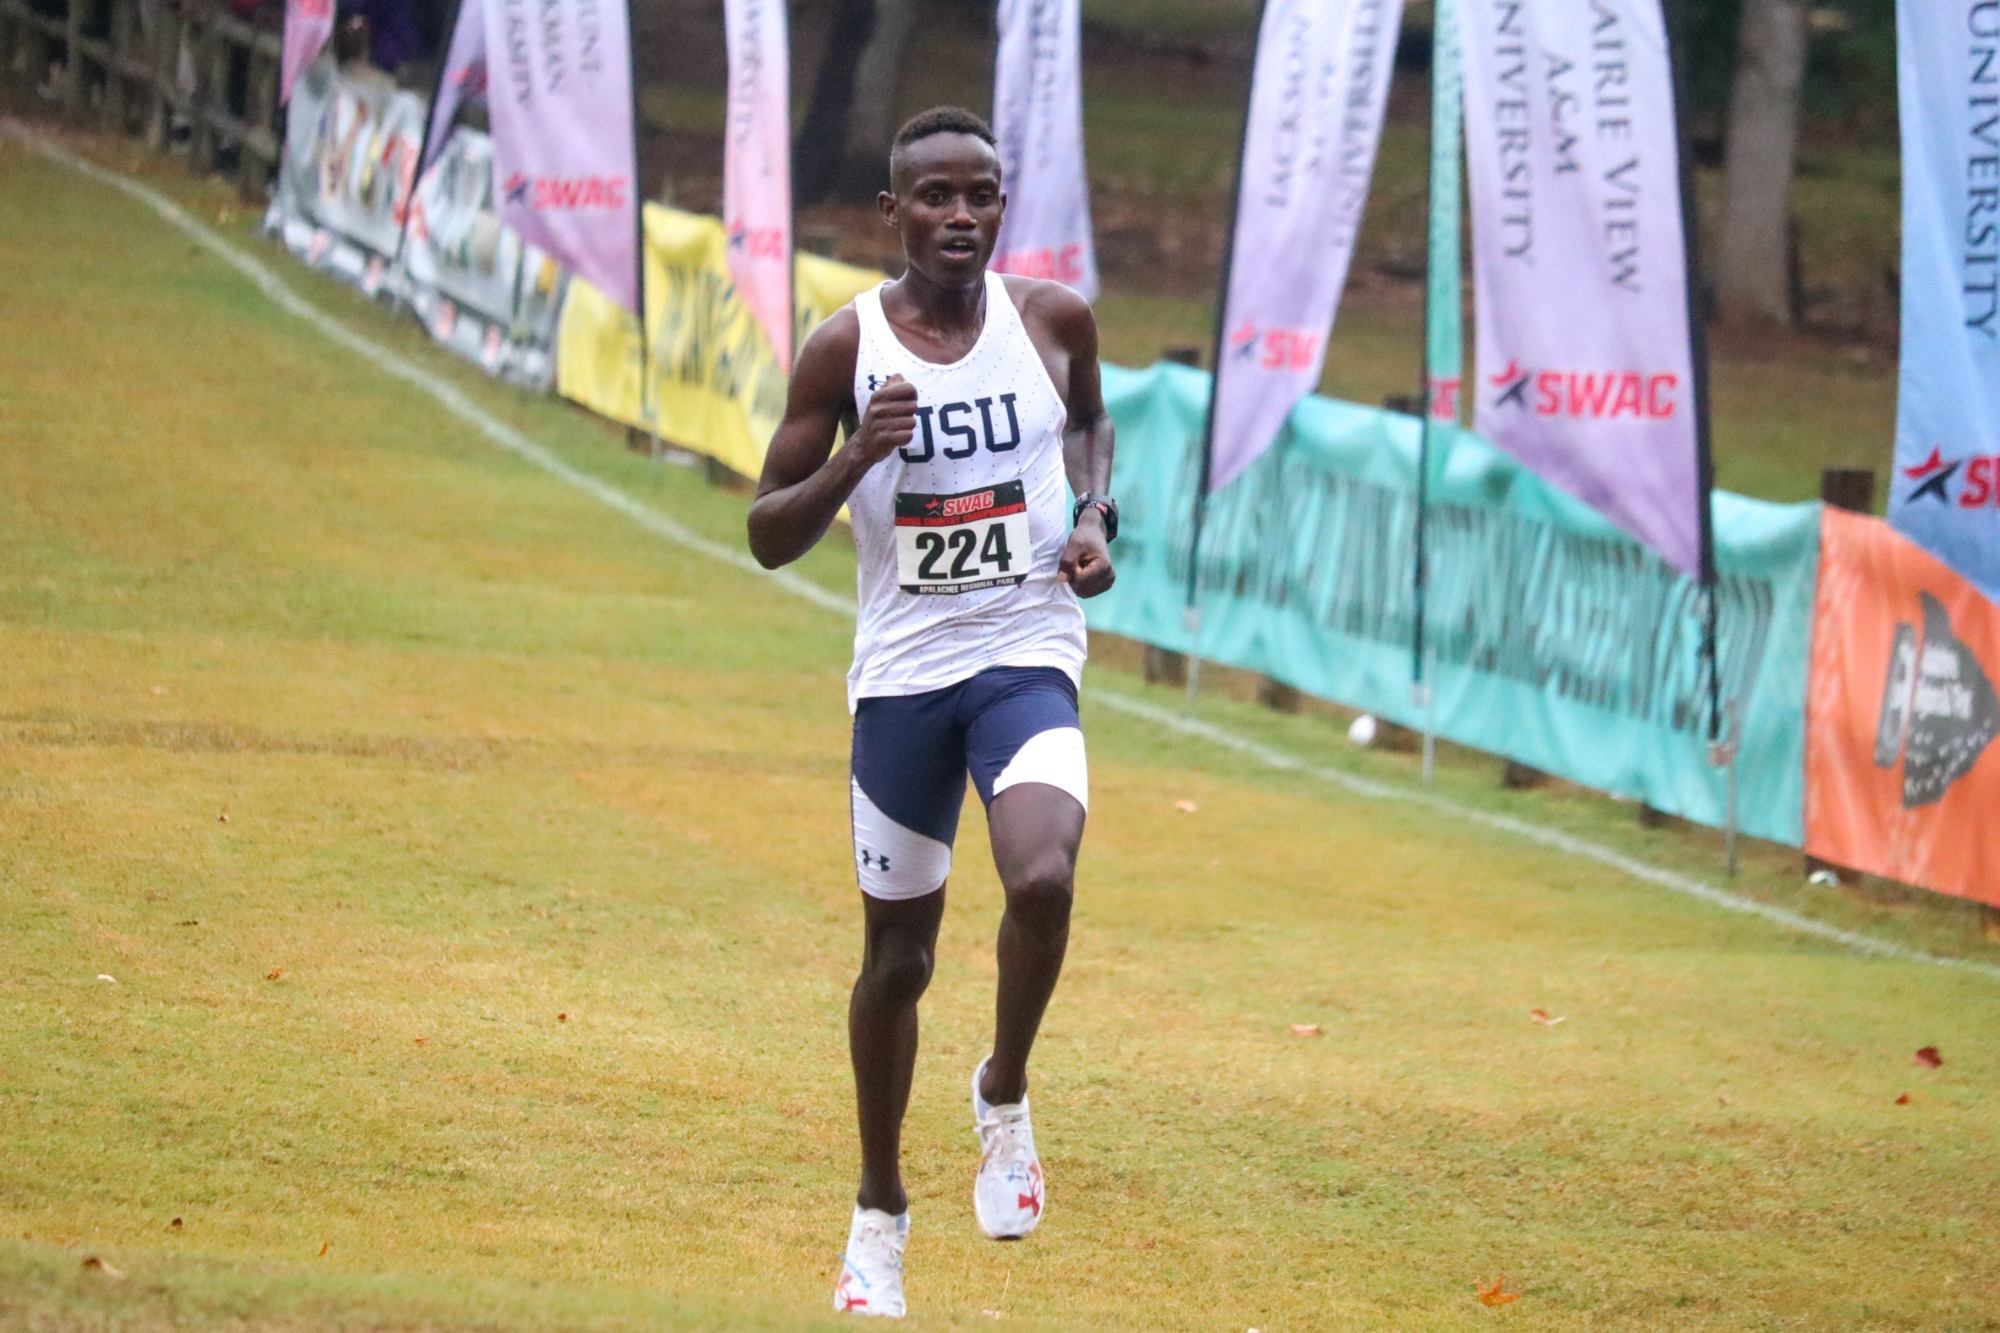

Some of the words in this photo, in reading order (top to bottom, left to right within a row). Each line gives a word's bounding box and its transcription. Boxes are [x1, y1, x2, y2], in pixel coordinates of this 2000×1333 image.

[1540, 52, 1582, 176] A&M
[532, 175, 626, 211] SWAC
[1963, 0, 2000, 341] UNIVERSITY
[1603, 156, 1643, 295] VIEW
[1535, 369, 1678, 421] SWAC
[899, 392, 1021, 463] JSU
[943, 490, 995, 516] SWAC
[915, 522, 1012, 580] 224
[919, 585, 959, 594] APALACHEE
[960, 579, 994, 591] REGIONAL
[996, 577, 1016, 585] PARK
